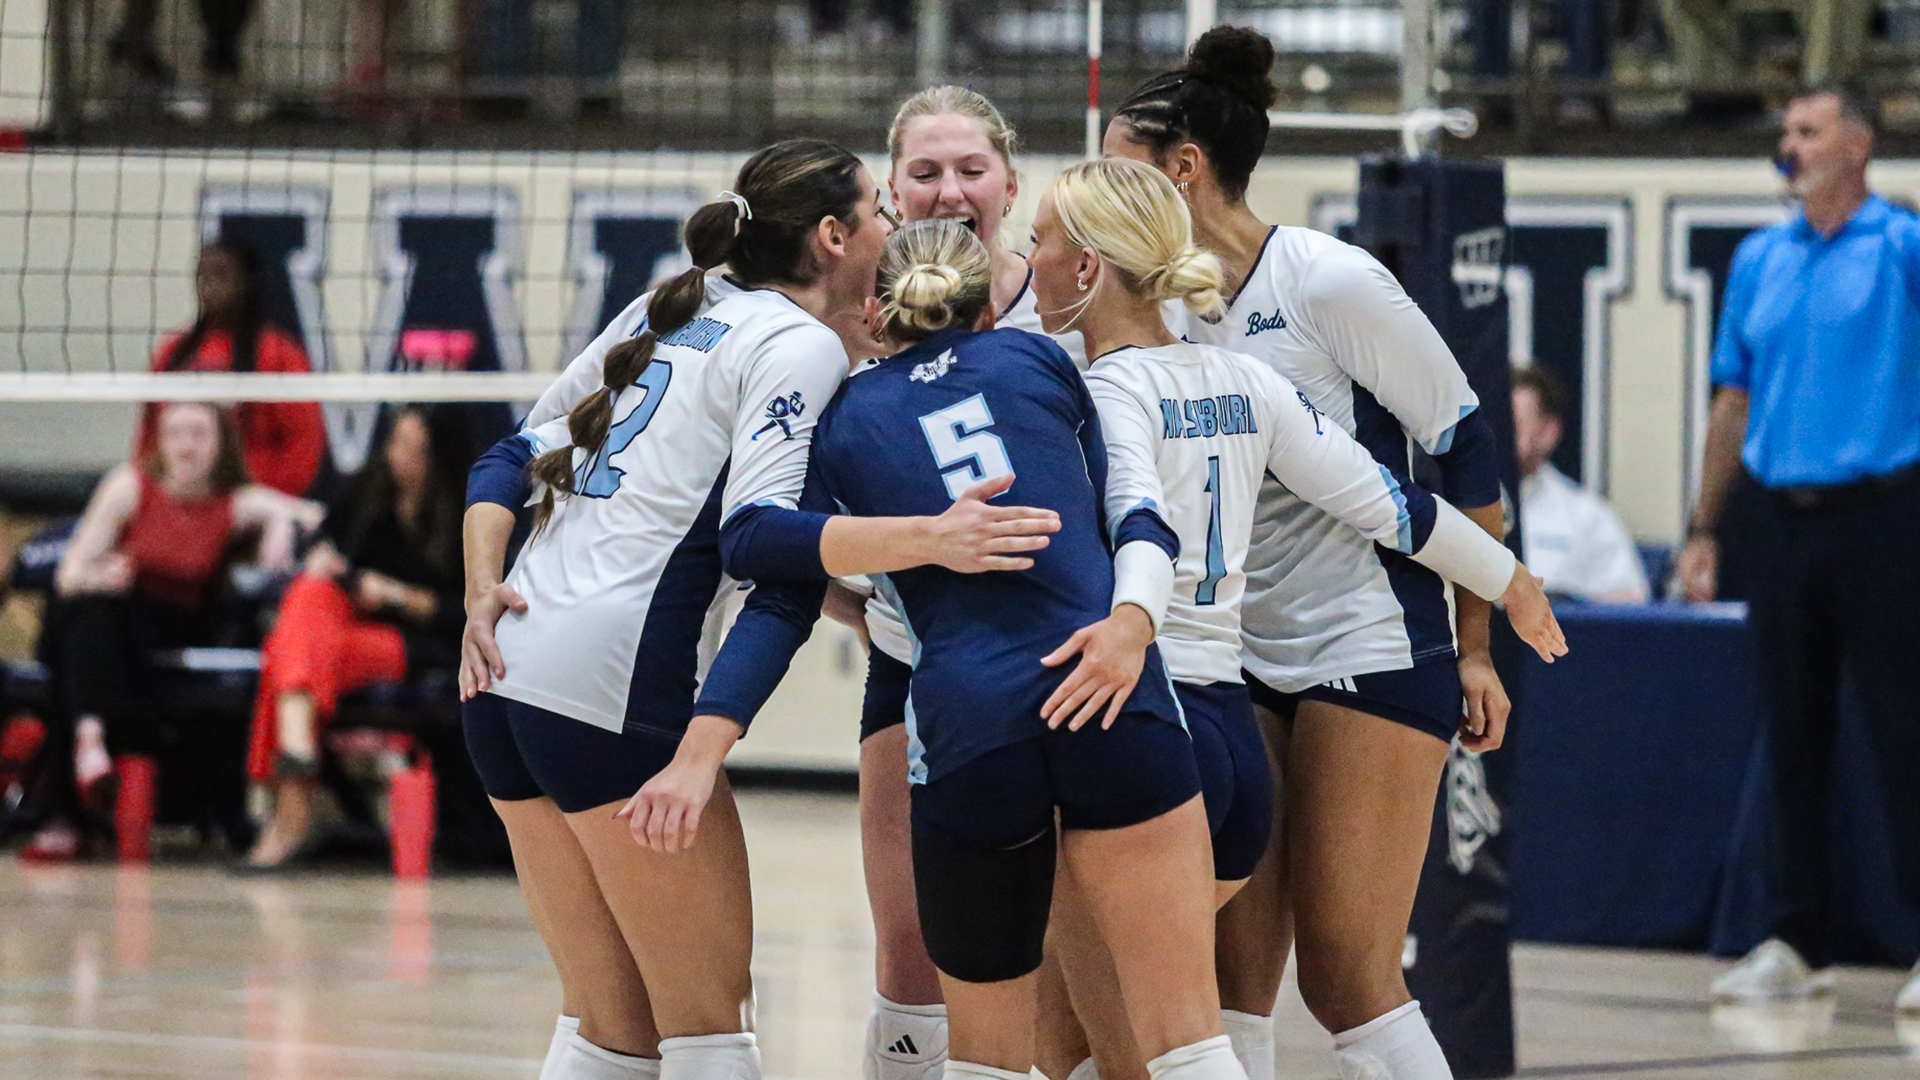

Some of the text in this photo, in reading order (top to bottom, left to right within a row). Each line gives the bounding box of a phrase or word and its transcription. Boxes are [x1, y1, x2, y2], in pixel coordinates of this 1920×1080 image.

[629, 312, 734, 354] BURN
[1245, 308, 1287, 337] Bods
[571, 358, 673, 499] 2
[918, 392, 1016, 502] 5
[1195, 454, 1228, 606] 1
